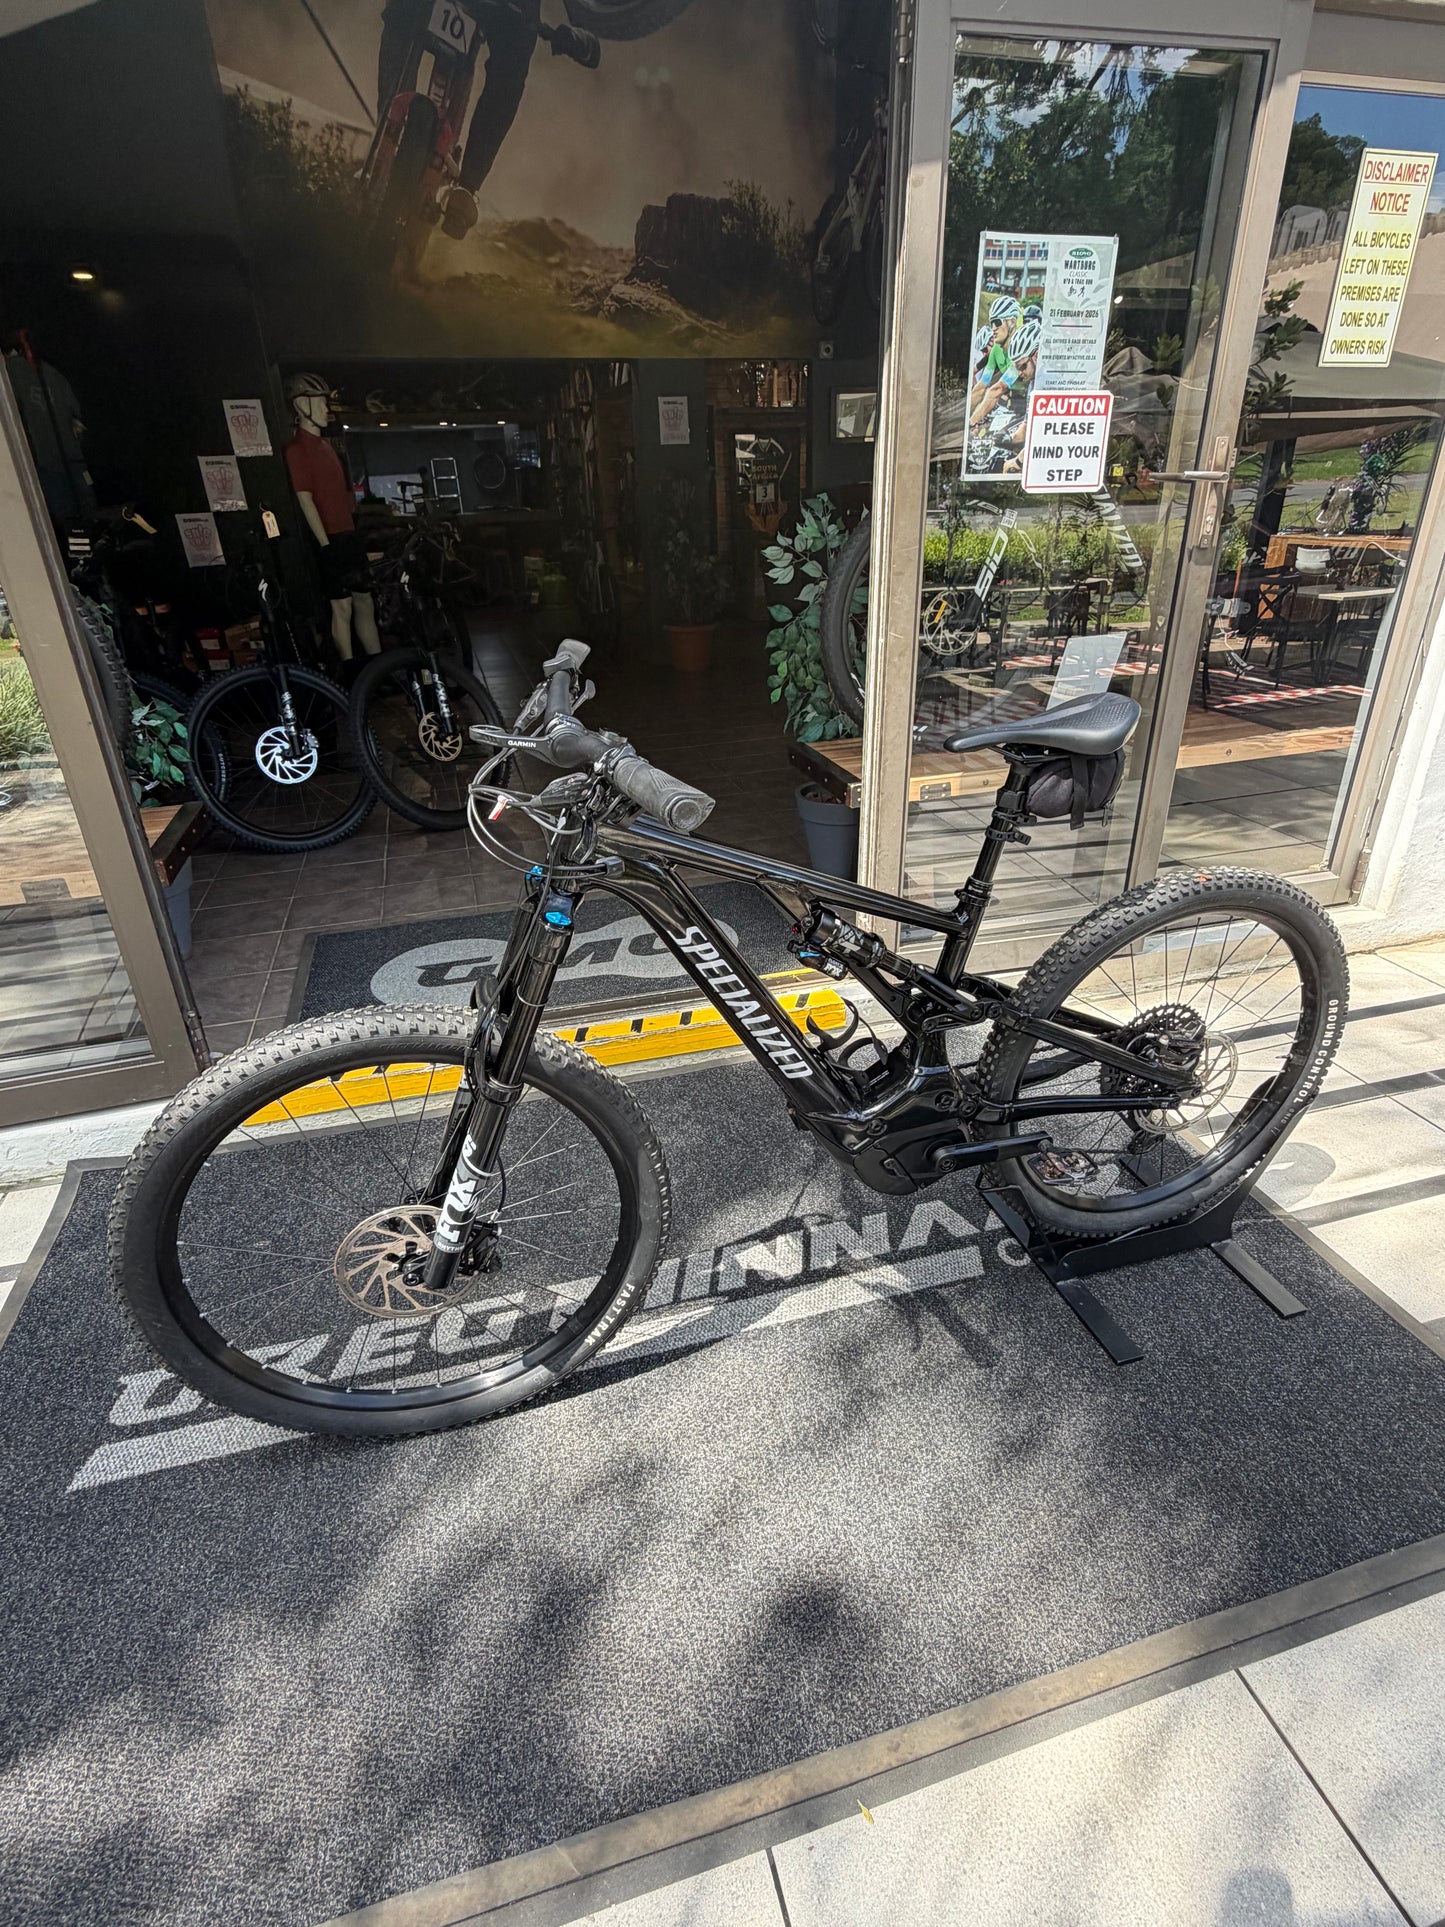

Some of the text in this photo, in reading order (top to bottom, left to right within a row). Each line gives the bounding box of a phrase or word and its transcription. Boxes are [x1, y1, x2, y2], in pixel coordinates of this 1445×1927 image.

[441, 9, 464, 39] 10
[1364, 160, 1430, 183] DISCLAIMER
[1370, 192, 1411, 213] NOTICE
[1352, 231, 1412, 249] ALL BICYCLES
[1063, 260, 1096, 270] WARTBURG
[1344, 259, 1408, 276] LEFT ON THESE
[1340, 286, 1401, 302] PREMISES ARE
[1050, 309, 1056, 317] 21
[1056, 309, 1084, 318] FEBRUARY
[1340, 312, 1389, 328] DONE SO AT
[1330, 339, 1387, 355] OWNERS RISK
[1036, 398, 1106, 415] CAUTION
[1044, 422, 1095, 435] PLEASE
[1032, 446, 1100, 459] MIND YOUR
[1046, 469, 1083, 482] STEP
[762, 487, 768, 498] 3
[507, 740, 537, 748] GARMIN
[824, 963, 843, 977] FOX
[667, 926, 814, 1079] SPECIALIZED
[1321, 999, 1339, 1047] GROUND
[1293, 1049, 1328, 1104] CONTROL
[436, 1168, 477, 1243] FOX
[585, 1282, 635, 1346] FAST TRAK
